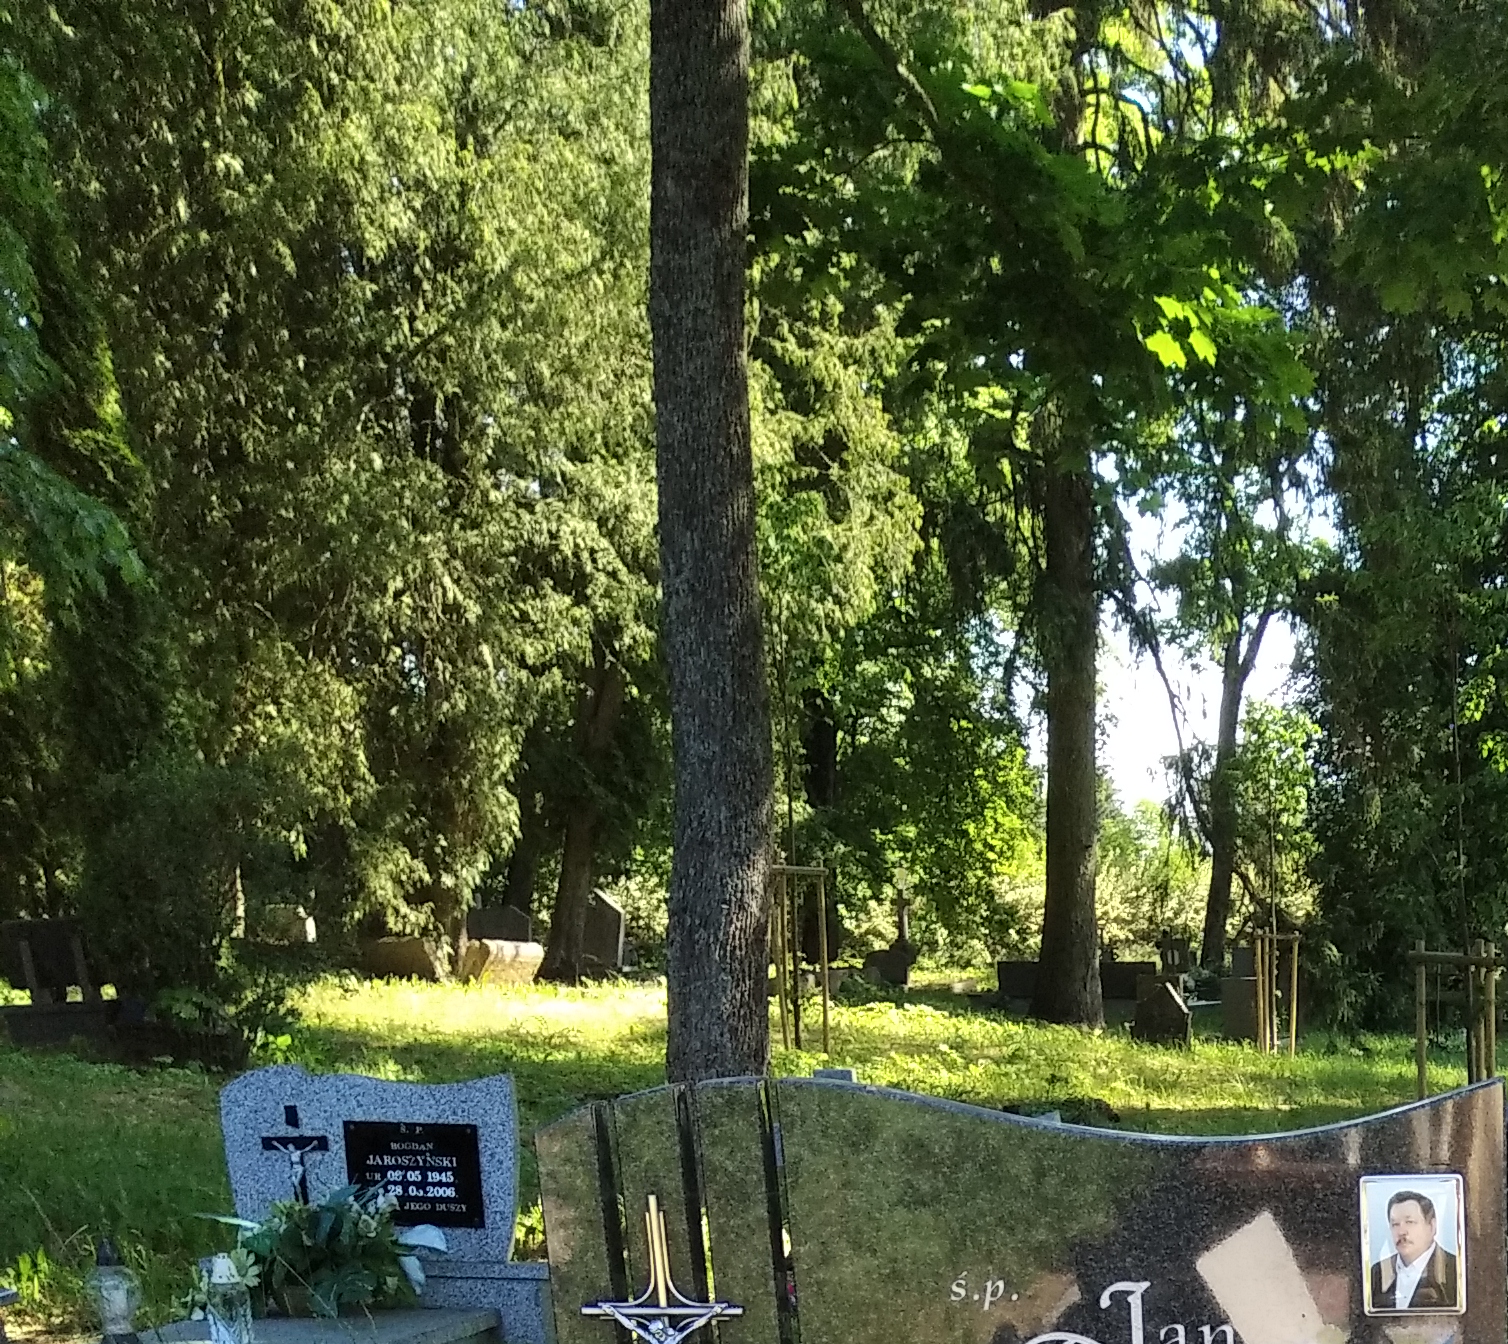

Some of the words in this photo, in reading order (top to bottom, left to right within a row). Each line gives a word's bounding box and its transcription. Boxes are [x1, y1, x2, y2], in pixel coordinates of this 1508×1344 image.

[390, 1141, 434, 1151] BOGDAN
[365, 1152, 457, 1168] JAROSZYŃSKI
[403, 1202, 432, 1211] JEGO
[435, 1202, 467, 1212] DUSZY
[950, 1271, 1020, 1311] ś.p.
